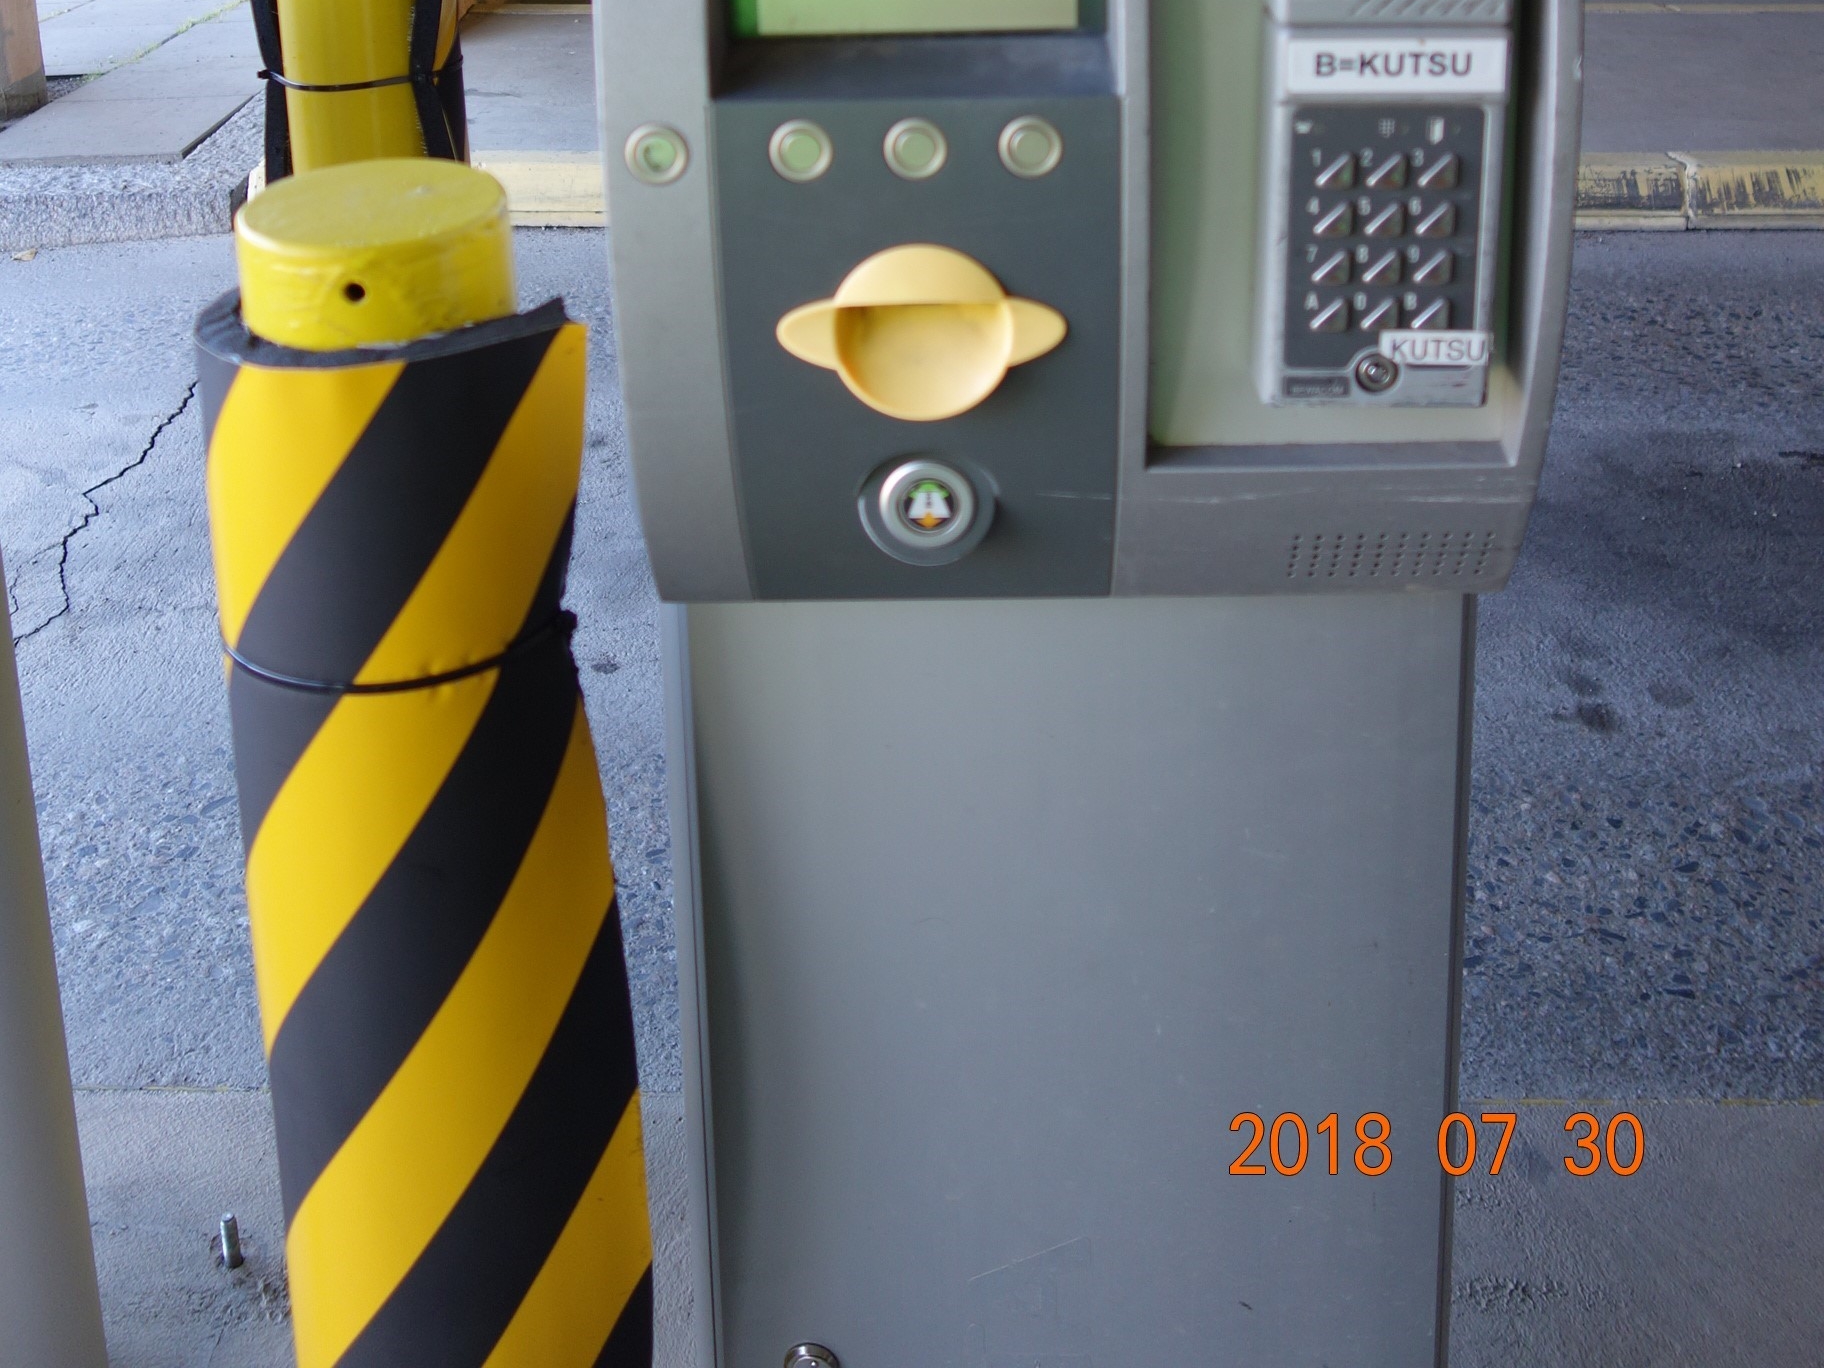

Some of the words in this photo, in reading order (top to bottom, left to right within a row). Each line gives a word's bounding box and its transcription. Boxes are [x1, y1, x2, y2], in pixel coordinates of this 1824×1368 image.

[1315, 52, 1472, 77] B=KUTSU
[1312, 148, 1321, 167] 1
[1360, 148, 1373, 167] 2
[1411, 148, 1424, 167] 3
[1306, 196, 1319, 215] 4
[1358, 196, 1371, 216] 5
[1409, 196, 1422, 216] 6
[1306, 244, 1318, 263] 7
[1356, 244, 1369, 264] 8
[1407, 244, 1420, 264] 9
[1304, 291, 1318, 311] A
[1391, 337, 1486, 361] KUTSU
